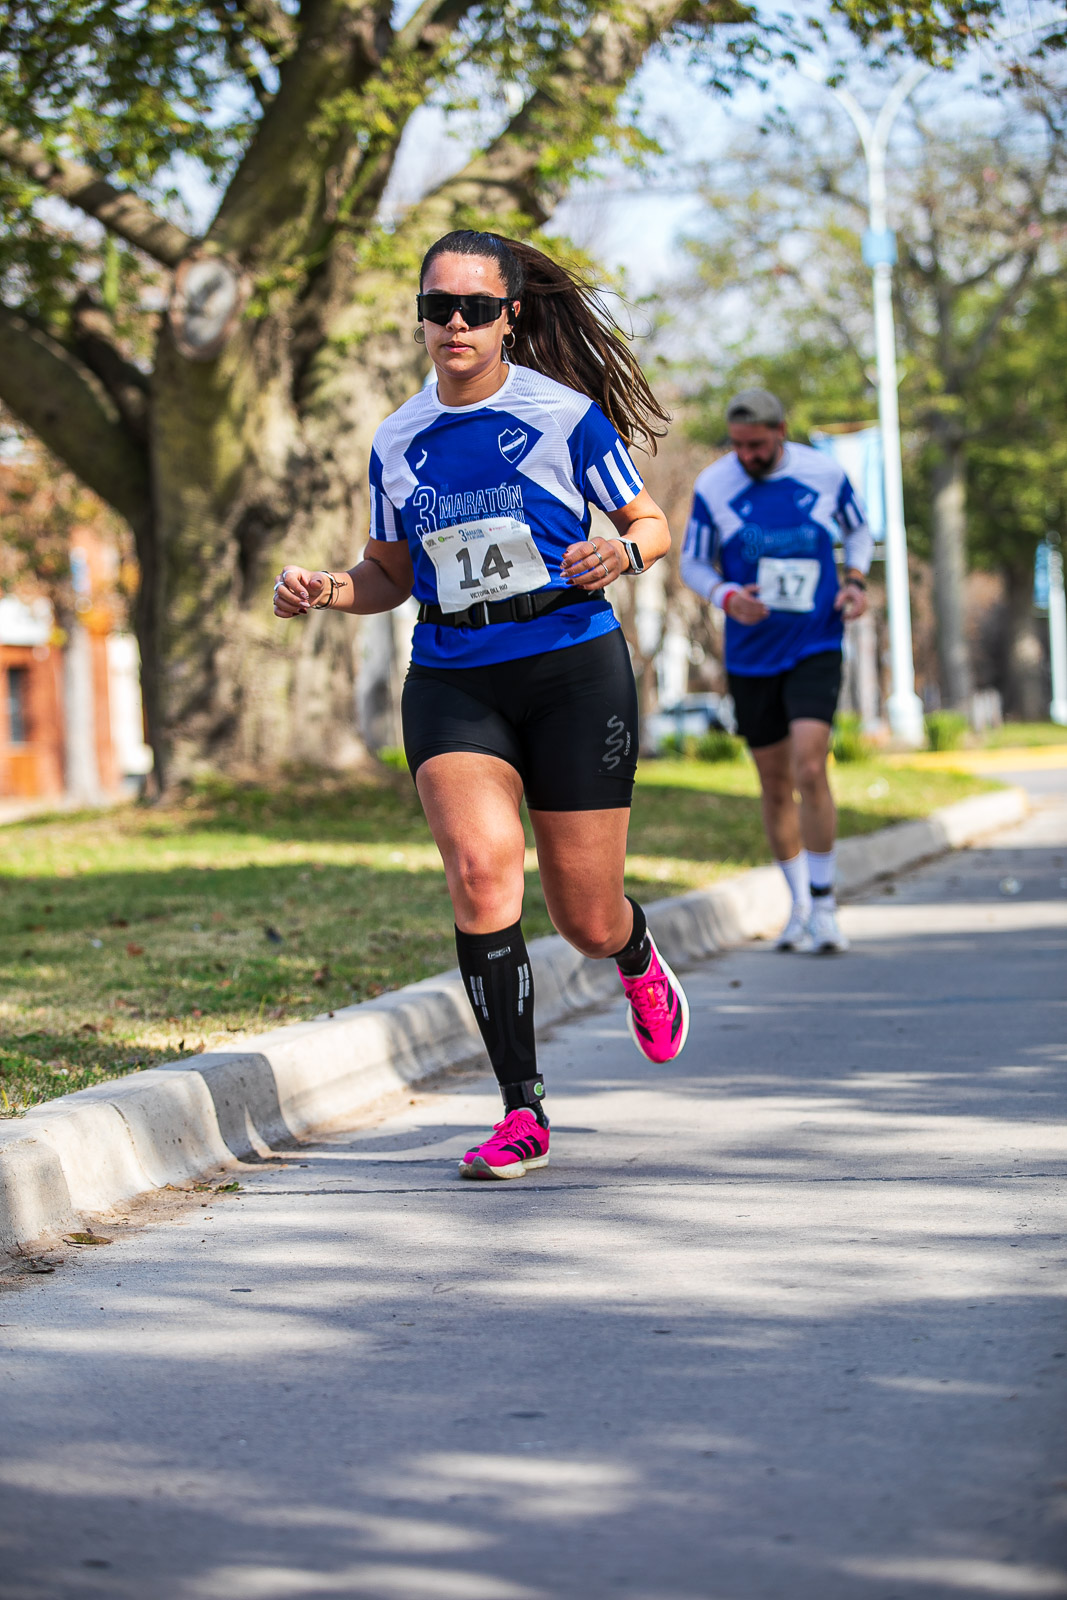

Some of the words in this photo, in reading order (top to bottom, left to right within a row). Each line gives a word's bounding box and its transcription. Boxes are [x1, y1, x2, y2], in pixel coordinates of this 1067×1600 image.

[412, 485, 438, 541] 3
[438, 482, 524, 520] MARATÓN
[455, 543, 514, 590] 14
[469, 588, 490, 600] VICTORIA
[777, 575, 806, 597] 17
